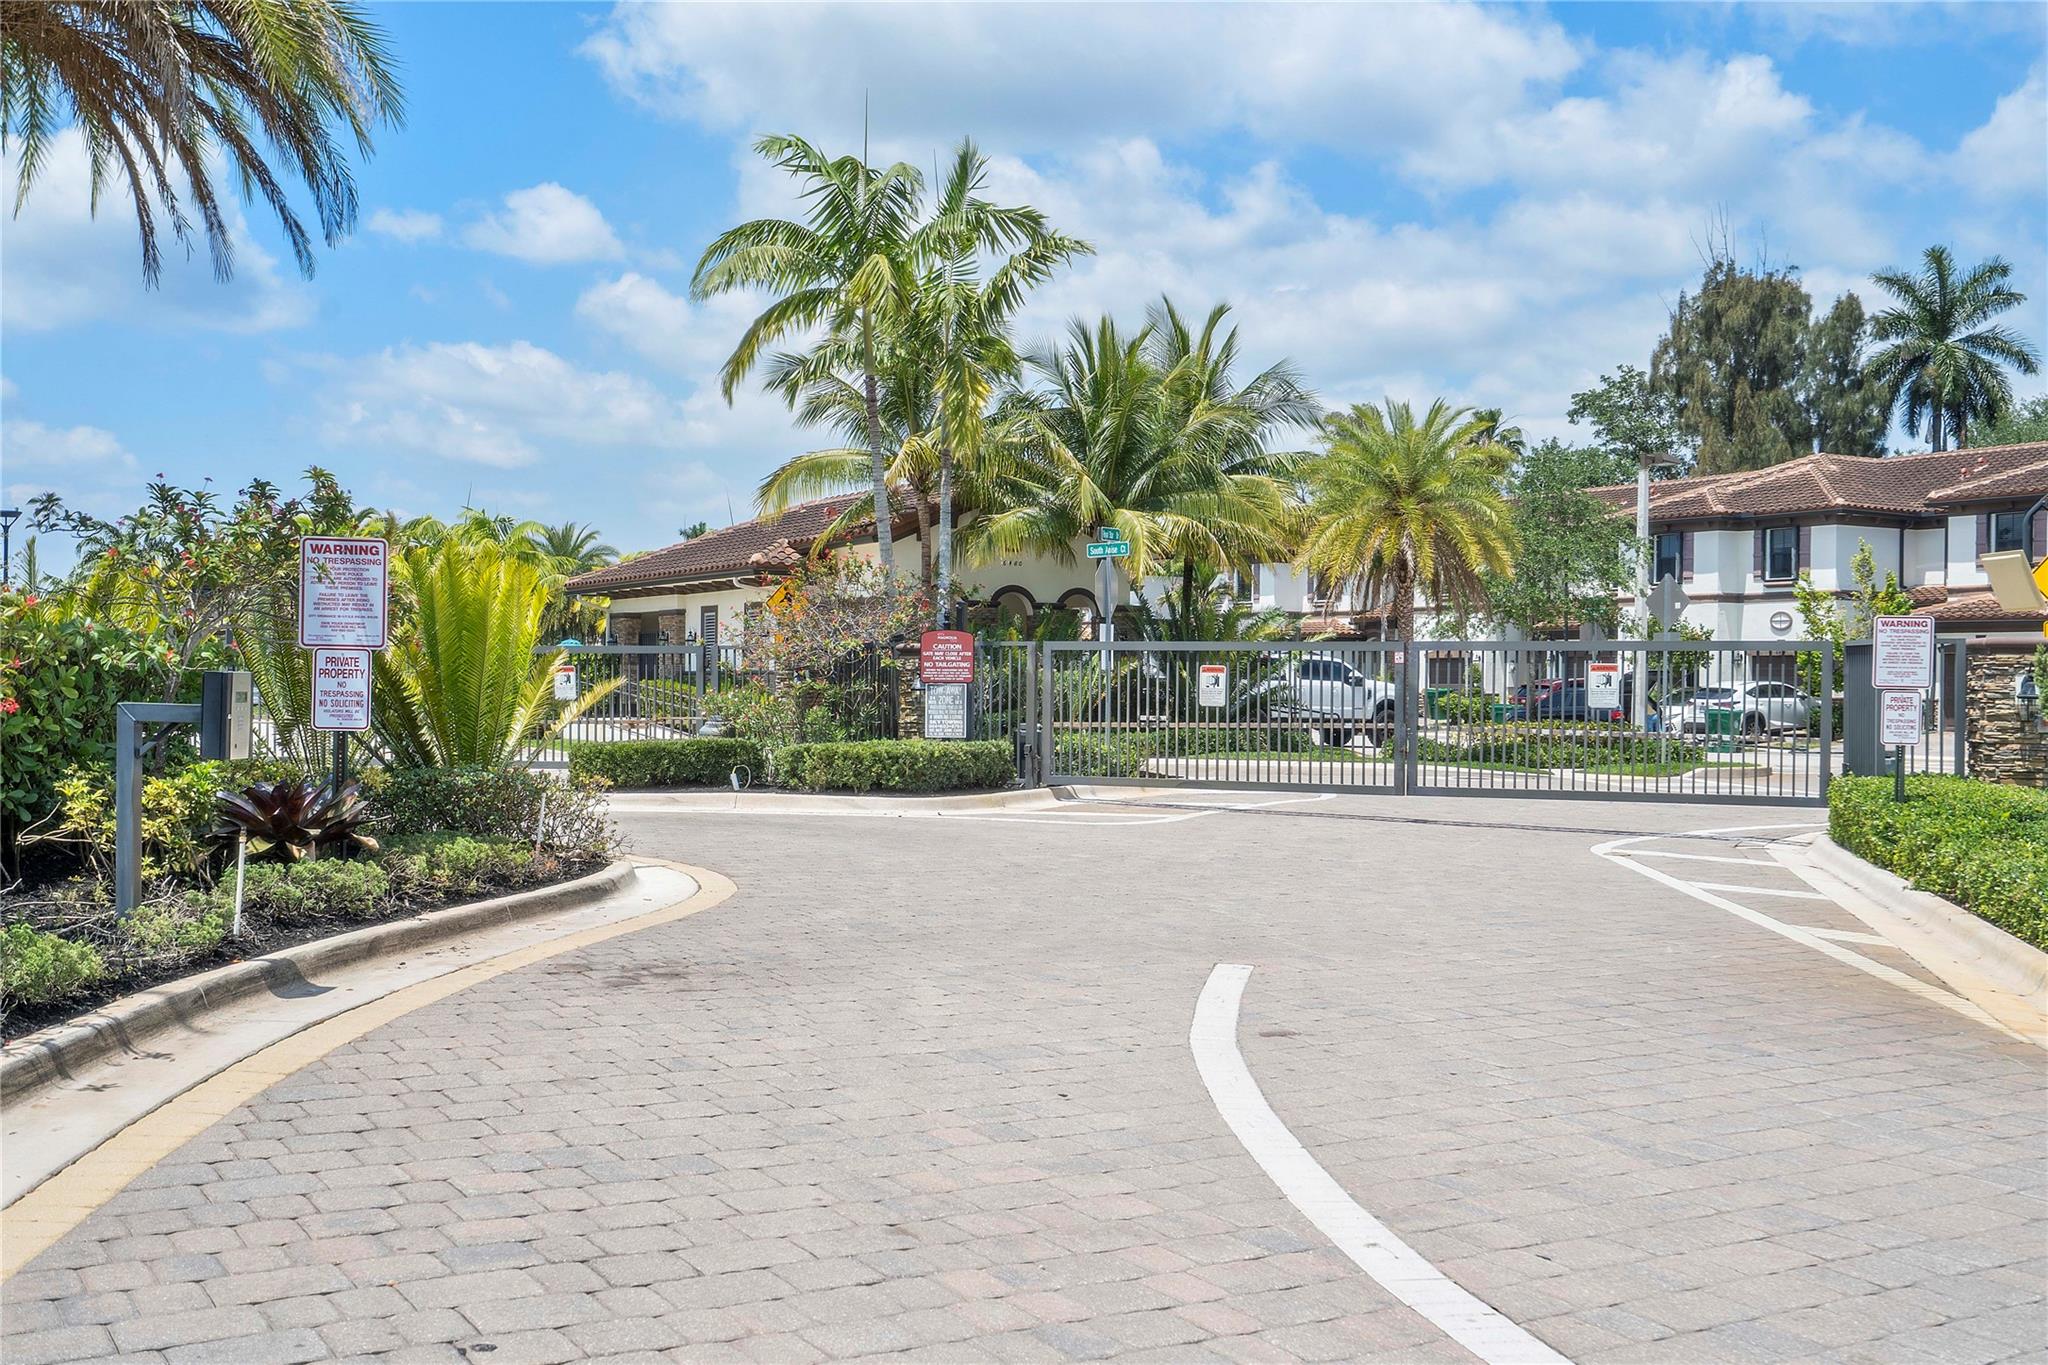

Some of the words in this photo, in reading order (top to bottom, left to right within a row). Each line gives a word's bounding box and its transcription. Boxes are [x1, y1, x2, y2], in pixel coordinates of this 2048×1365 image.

[310, 544, 380, 556] WARNING
[1090, 546, 1104, 555] South
[322, 557, 382, 566] TRESPASSING
[325, 657, 360, 667] PRIVATE
[318, 668, 365, 679] PROPERTY
[319, 699, 328, 707] NO
[330, 699, 364, 708] SOLICITING
